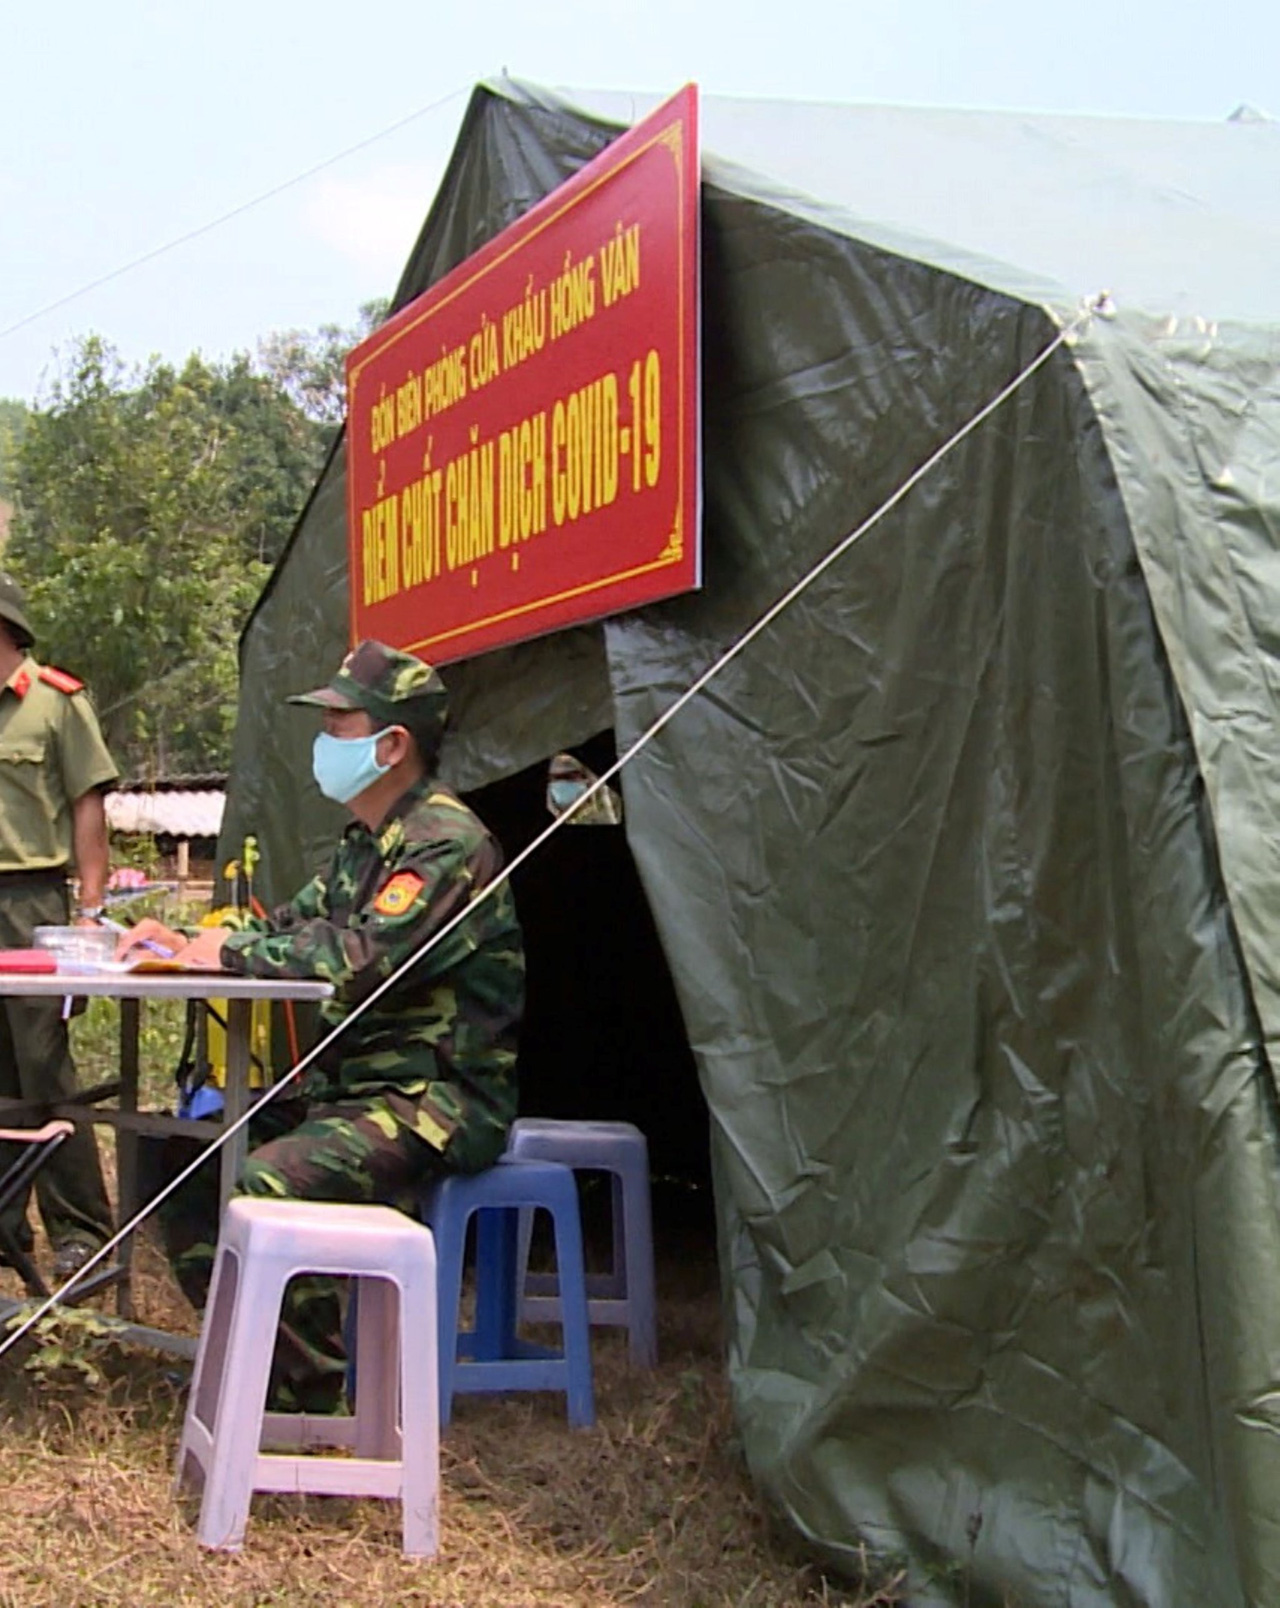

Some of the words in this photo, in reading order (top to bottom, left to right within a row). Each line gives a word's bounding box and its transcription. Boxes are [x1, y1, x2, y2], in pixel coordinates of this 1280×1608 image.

[396, 370, 422, 439] BIÊN
[424, 345, 466, 421] PHÒNG
[470, 313, 499, 390] CỬA
[503, 274, 546, 370] KHẨU
[601, 220, 639, 307] VÂN
[362, 459, 398, 607] ĐIỂM
[402, 435, 442, 590] CHỐT
[446, 424, 494, 588] CHẶN
[499, 411, 546, 571] DỊCH
[552, 349, 661, 526] COVID-19
